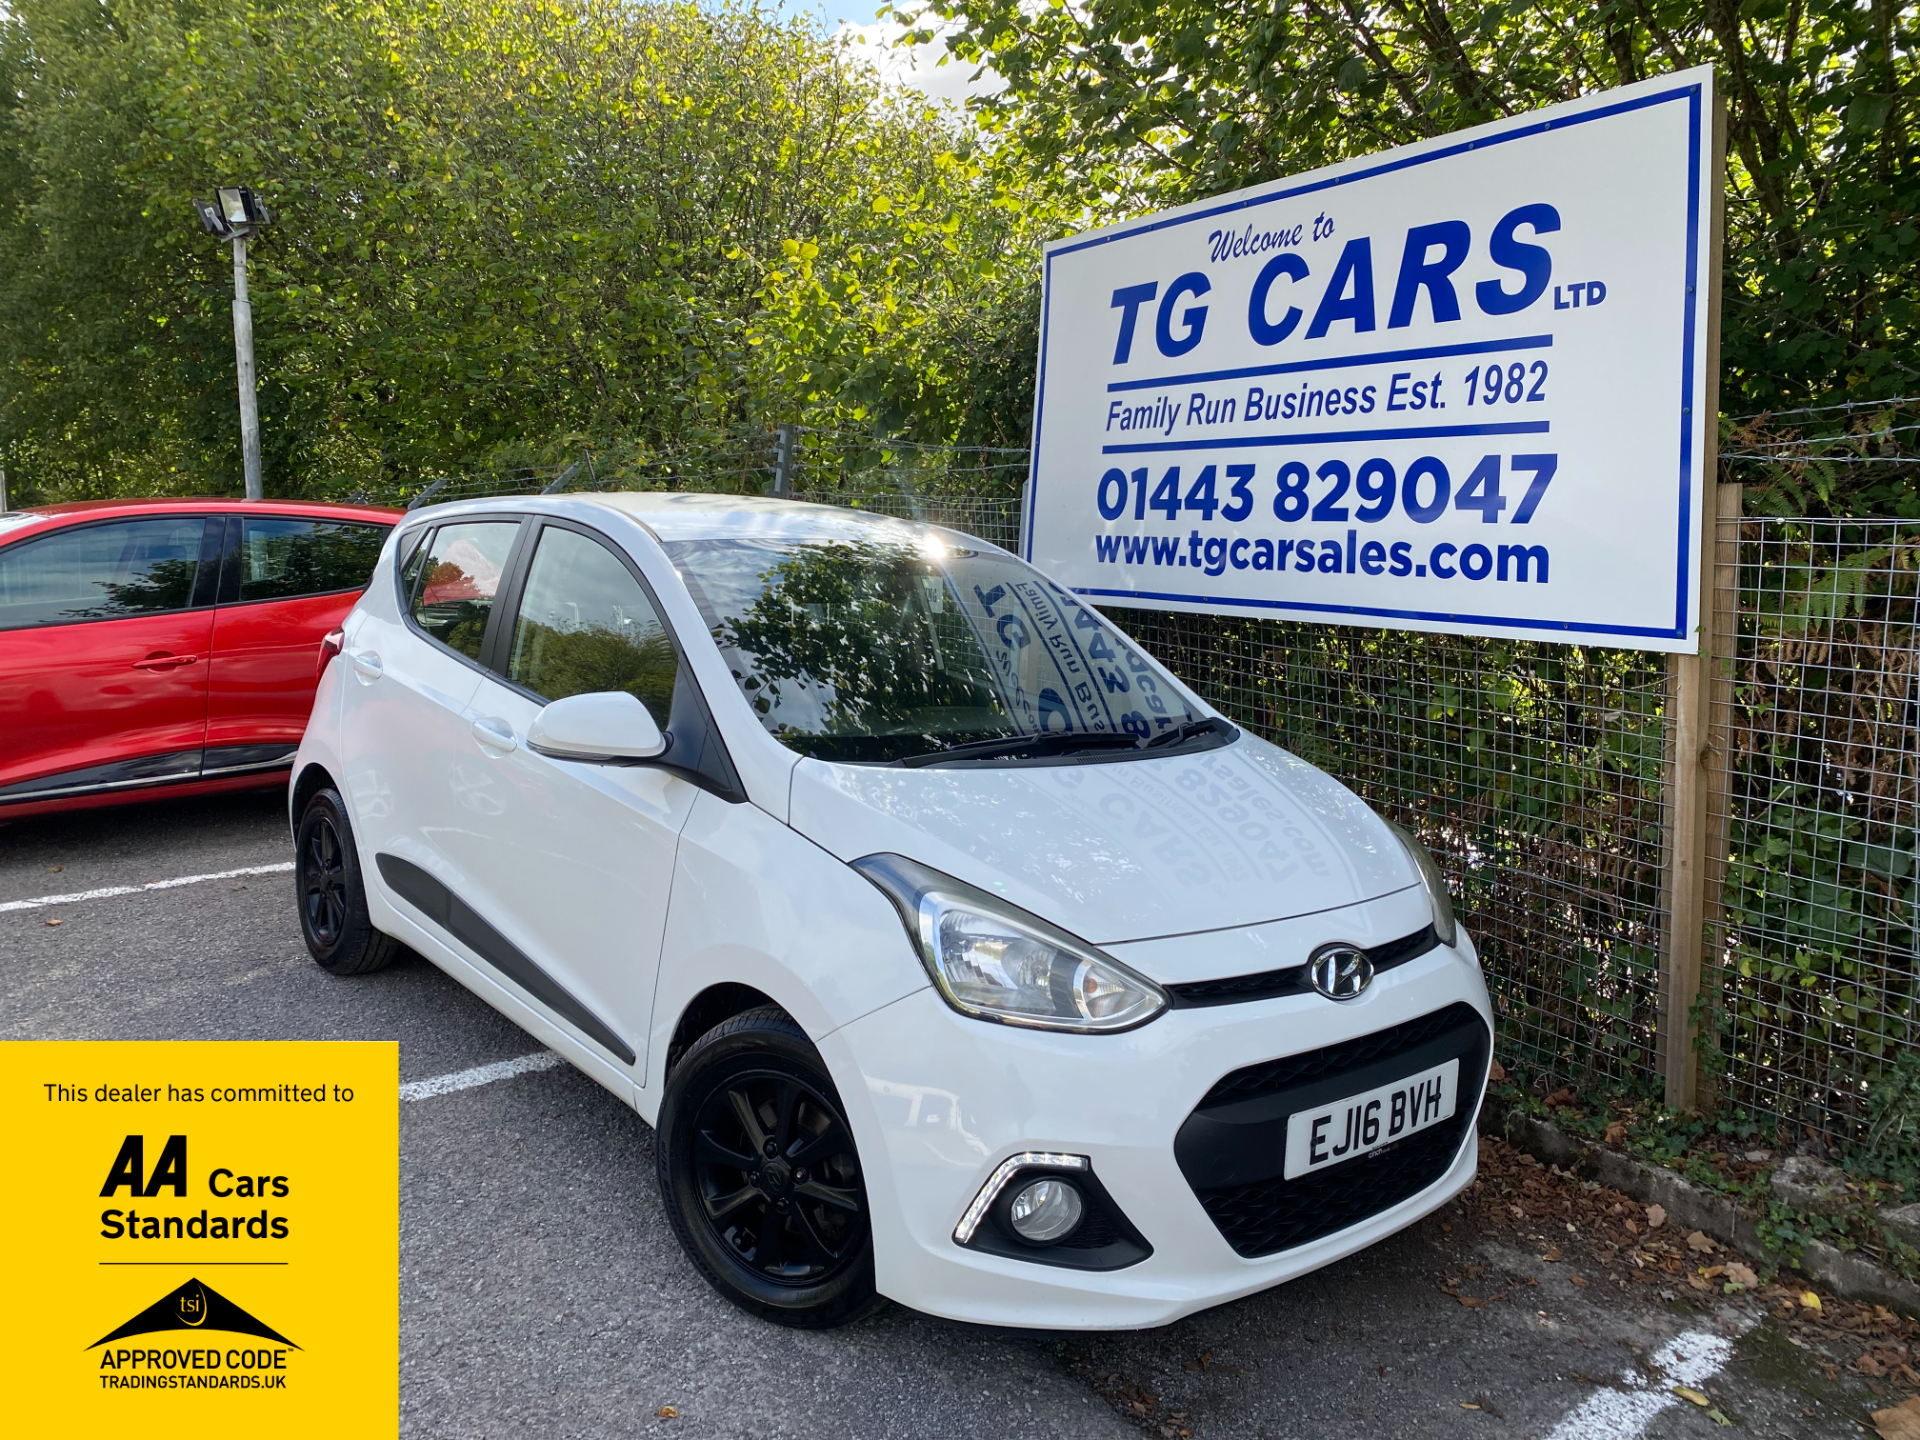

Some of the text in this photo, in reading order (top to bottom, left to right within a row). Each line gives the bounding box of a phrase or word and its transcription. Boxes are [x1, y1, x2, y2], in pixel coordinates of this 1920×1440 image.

[1208, 211, 1334, 263] Welcome to
[1110, 202, 1607, 365] TG CARS LTD
[1106, 360, 1549, 437] Family Run Business Est. 1982
[1096, 453, 1558, 525] 01443 829047
[1095, 529, 1550, 584] www.tgcarsales.com
[1308, 1074, 1443, 1167] EJ16 BVH
